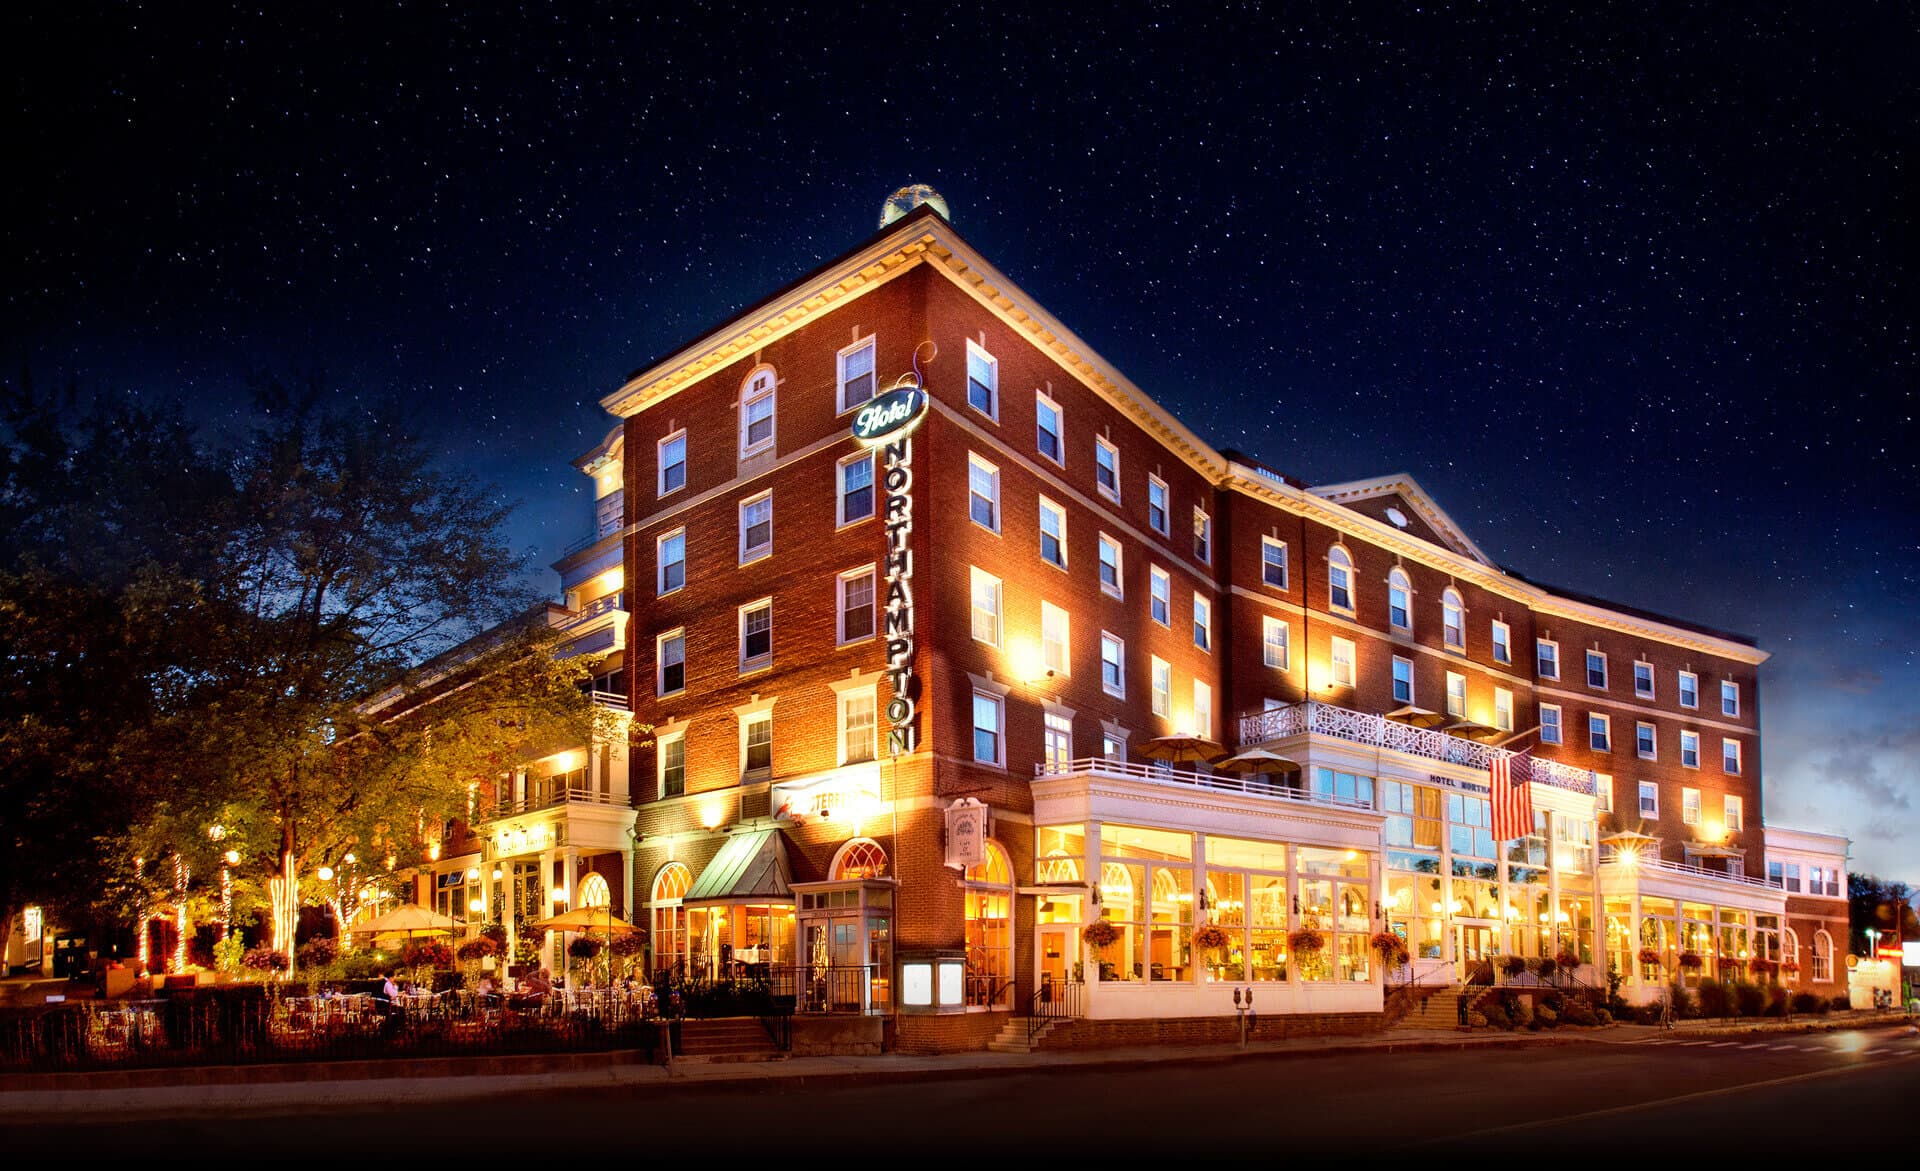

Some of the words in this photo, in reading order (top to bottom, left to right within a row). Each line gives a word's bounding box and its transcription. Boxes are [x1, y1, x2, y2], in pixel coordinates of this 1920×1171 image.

[856, 391, 915, 437] Hotel
[884, 438, 911, 753] NORTHAMPTON
[1430, 774, 1456, 787] HOTEL
